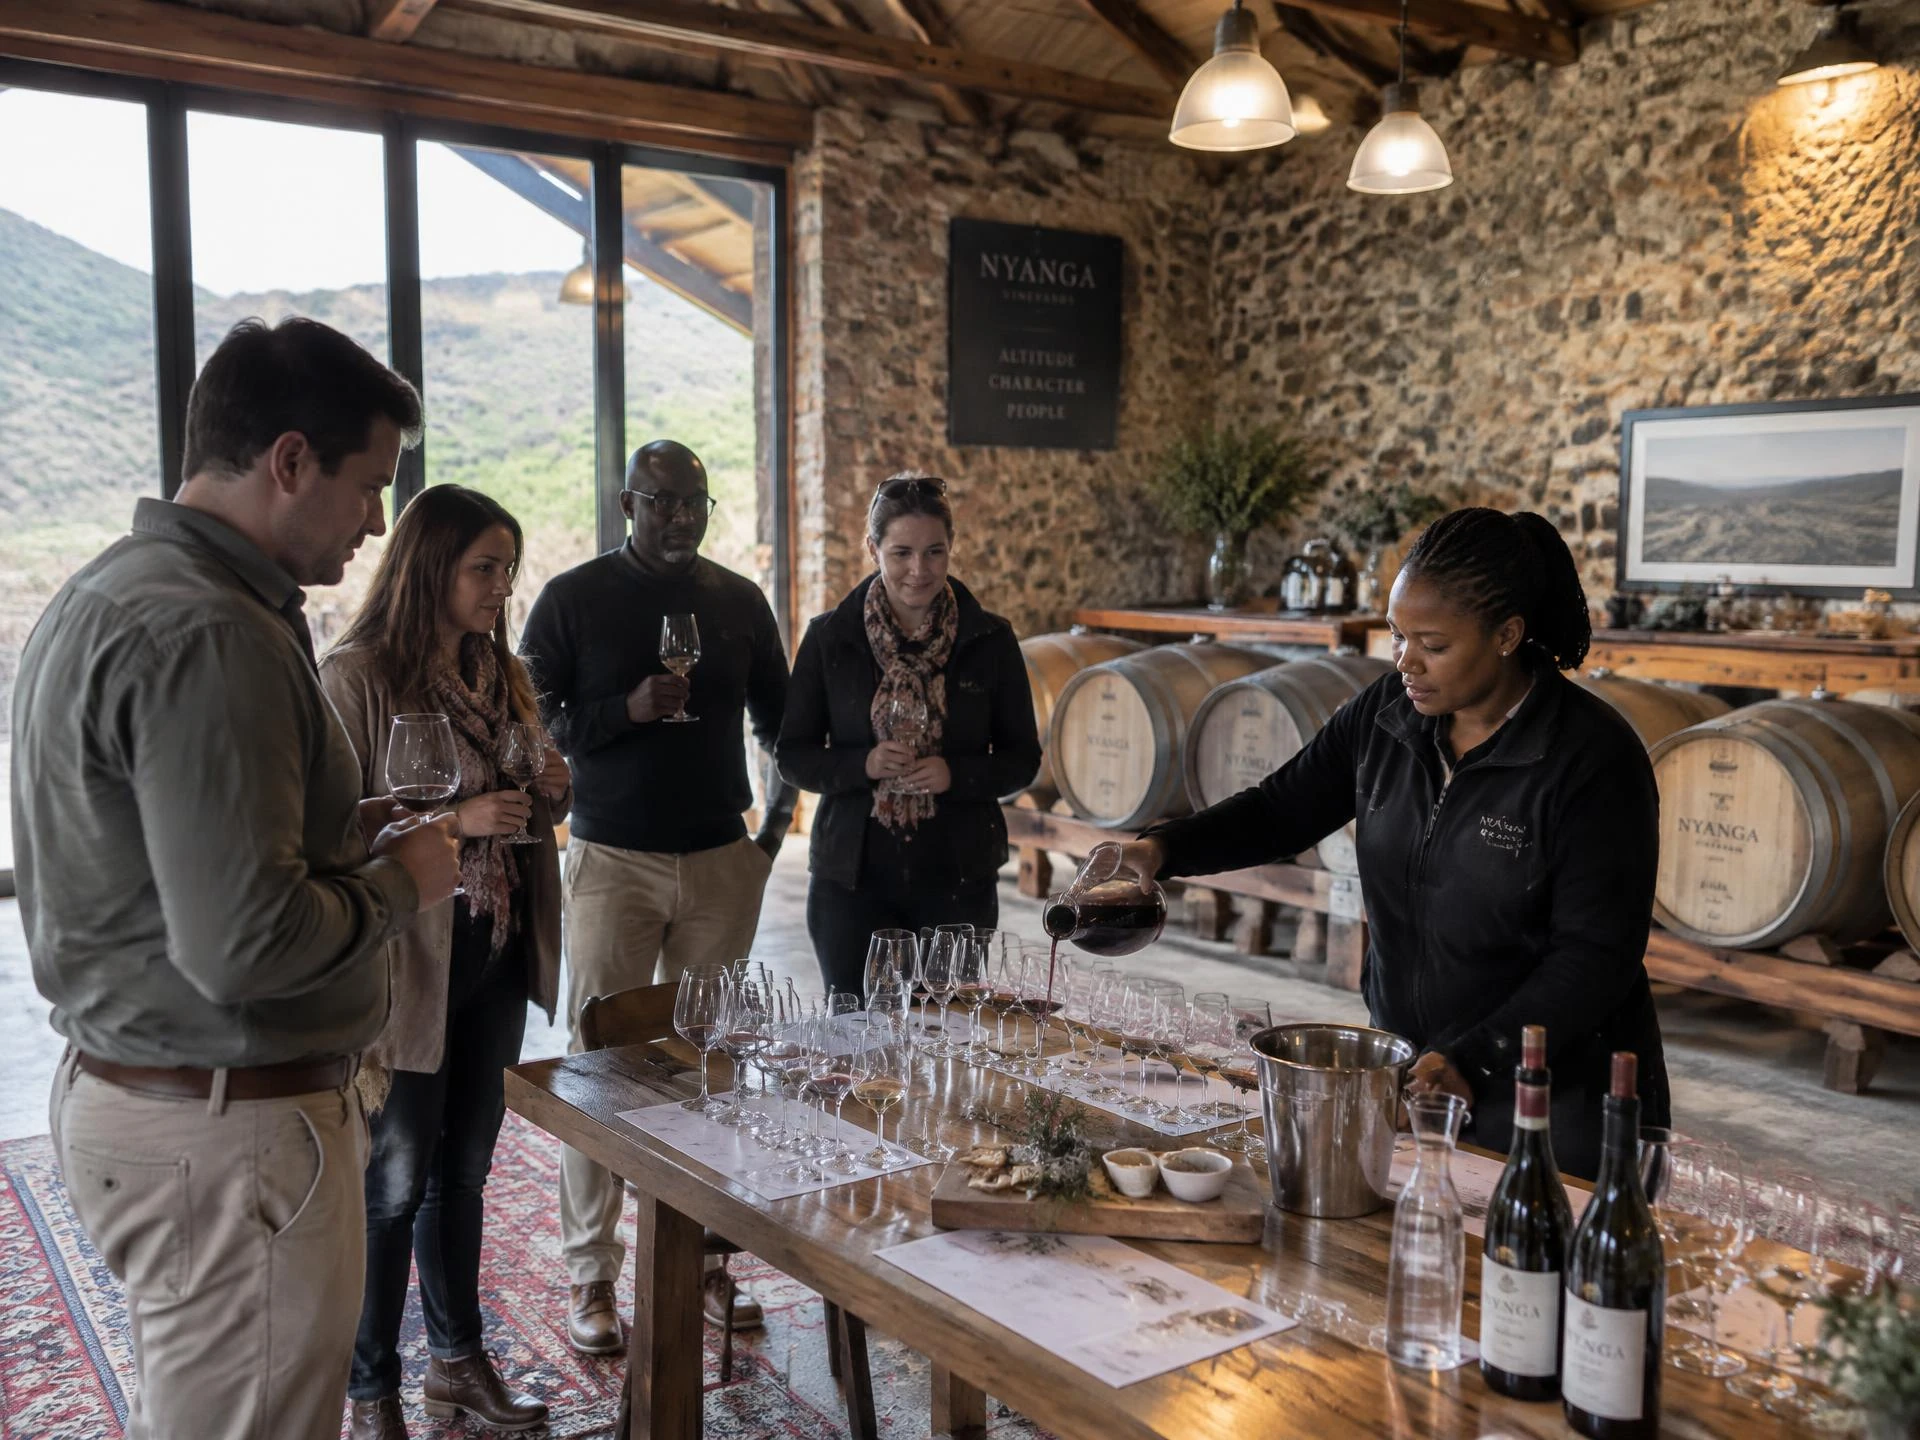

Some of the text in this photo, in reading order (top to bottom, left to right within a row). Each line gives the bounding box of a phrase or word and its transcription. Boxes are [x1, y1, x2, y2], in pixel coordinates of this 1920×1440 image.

[980, 251, 1096, 289] NYANGA
[998, 347, 1076, 368] ALTITUDE
[988, 373, 1086, 394] CHARACTER
[1006, 402, 1066, 420] PEOPLE
[1678, 817, 1760, 843] NYANGA
